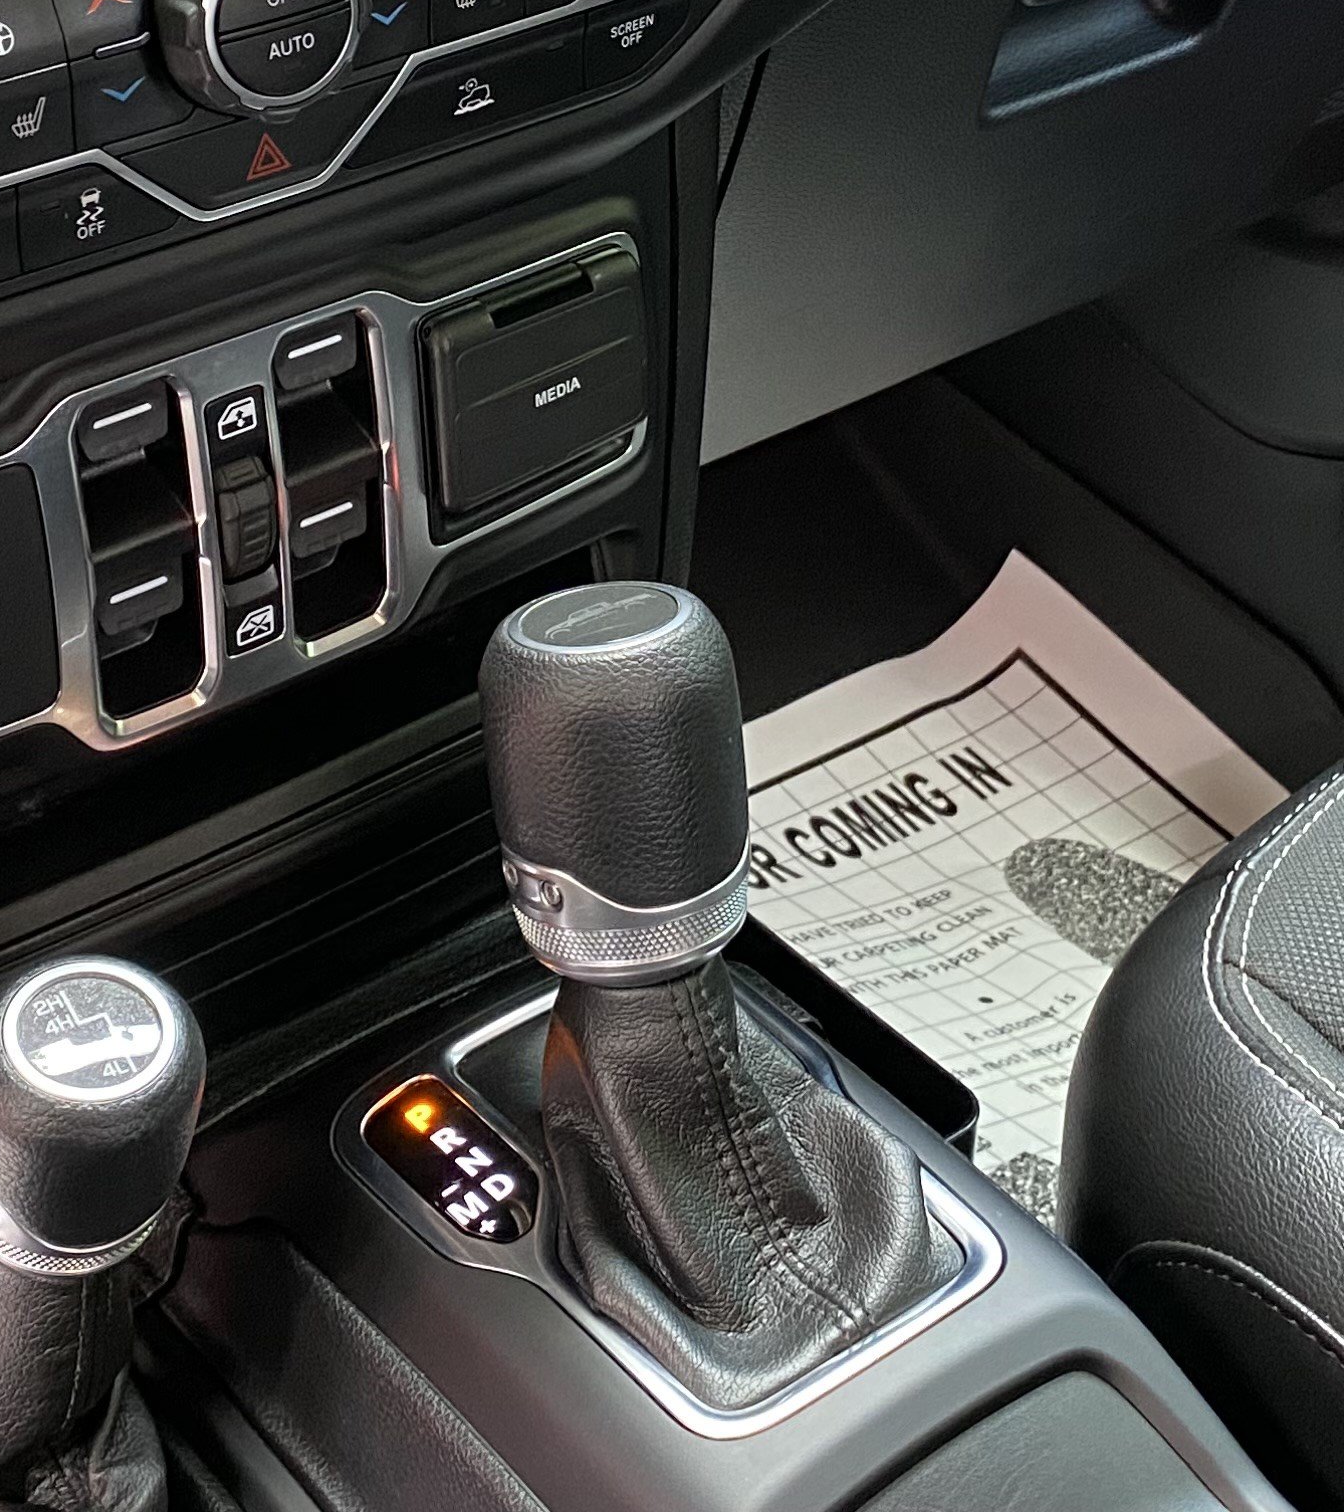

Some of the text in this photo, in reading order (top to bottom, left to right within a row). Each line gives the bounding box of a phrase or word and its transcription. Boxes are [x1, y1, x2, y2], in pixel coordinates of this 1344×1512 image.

[610, 13, 656, 38] SCREEN
[621, 31, 644, 49] OFF
[269, 32, 315, 60] AUTO
[76, 219, 106, 240] OFF
[535, 376, 581, 408] MEDIA
[783, 772, 958, 868] COMING
[938, 747, 1013, 801] IN
[833, 913, 885, 933] TRIED
[883, 905, 913, 921] TO
[910, 889, 952, 910] KEEP
[842, 930, 938, 962] CARPETING
[936, 905, 993, 933] CLEAN
[884, 967, 928, 984] THIS
[926, 946, 986, 975] PAPER
[982, 926, 1023, 950] MAT
[33, 993, 65, 1017] 2H
[964, 993, 1077, 1043] A customer is
[45, 1013, 75, 1035] 4H
[103, 1060, 130, 1077] 4L
[405, 1104, 515, 1202] P R N D
[446, 1190, 489, 1226] M
